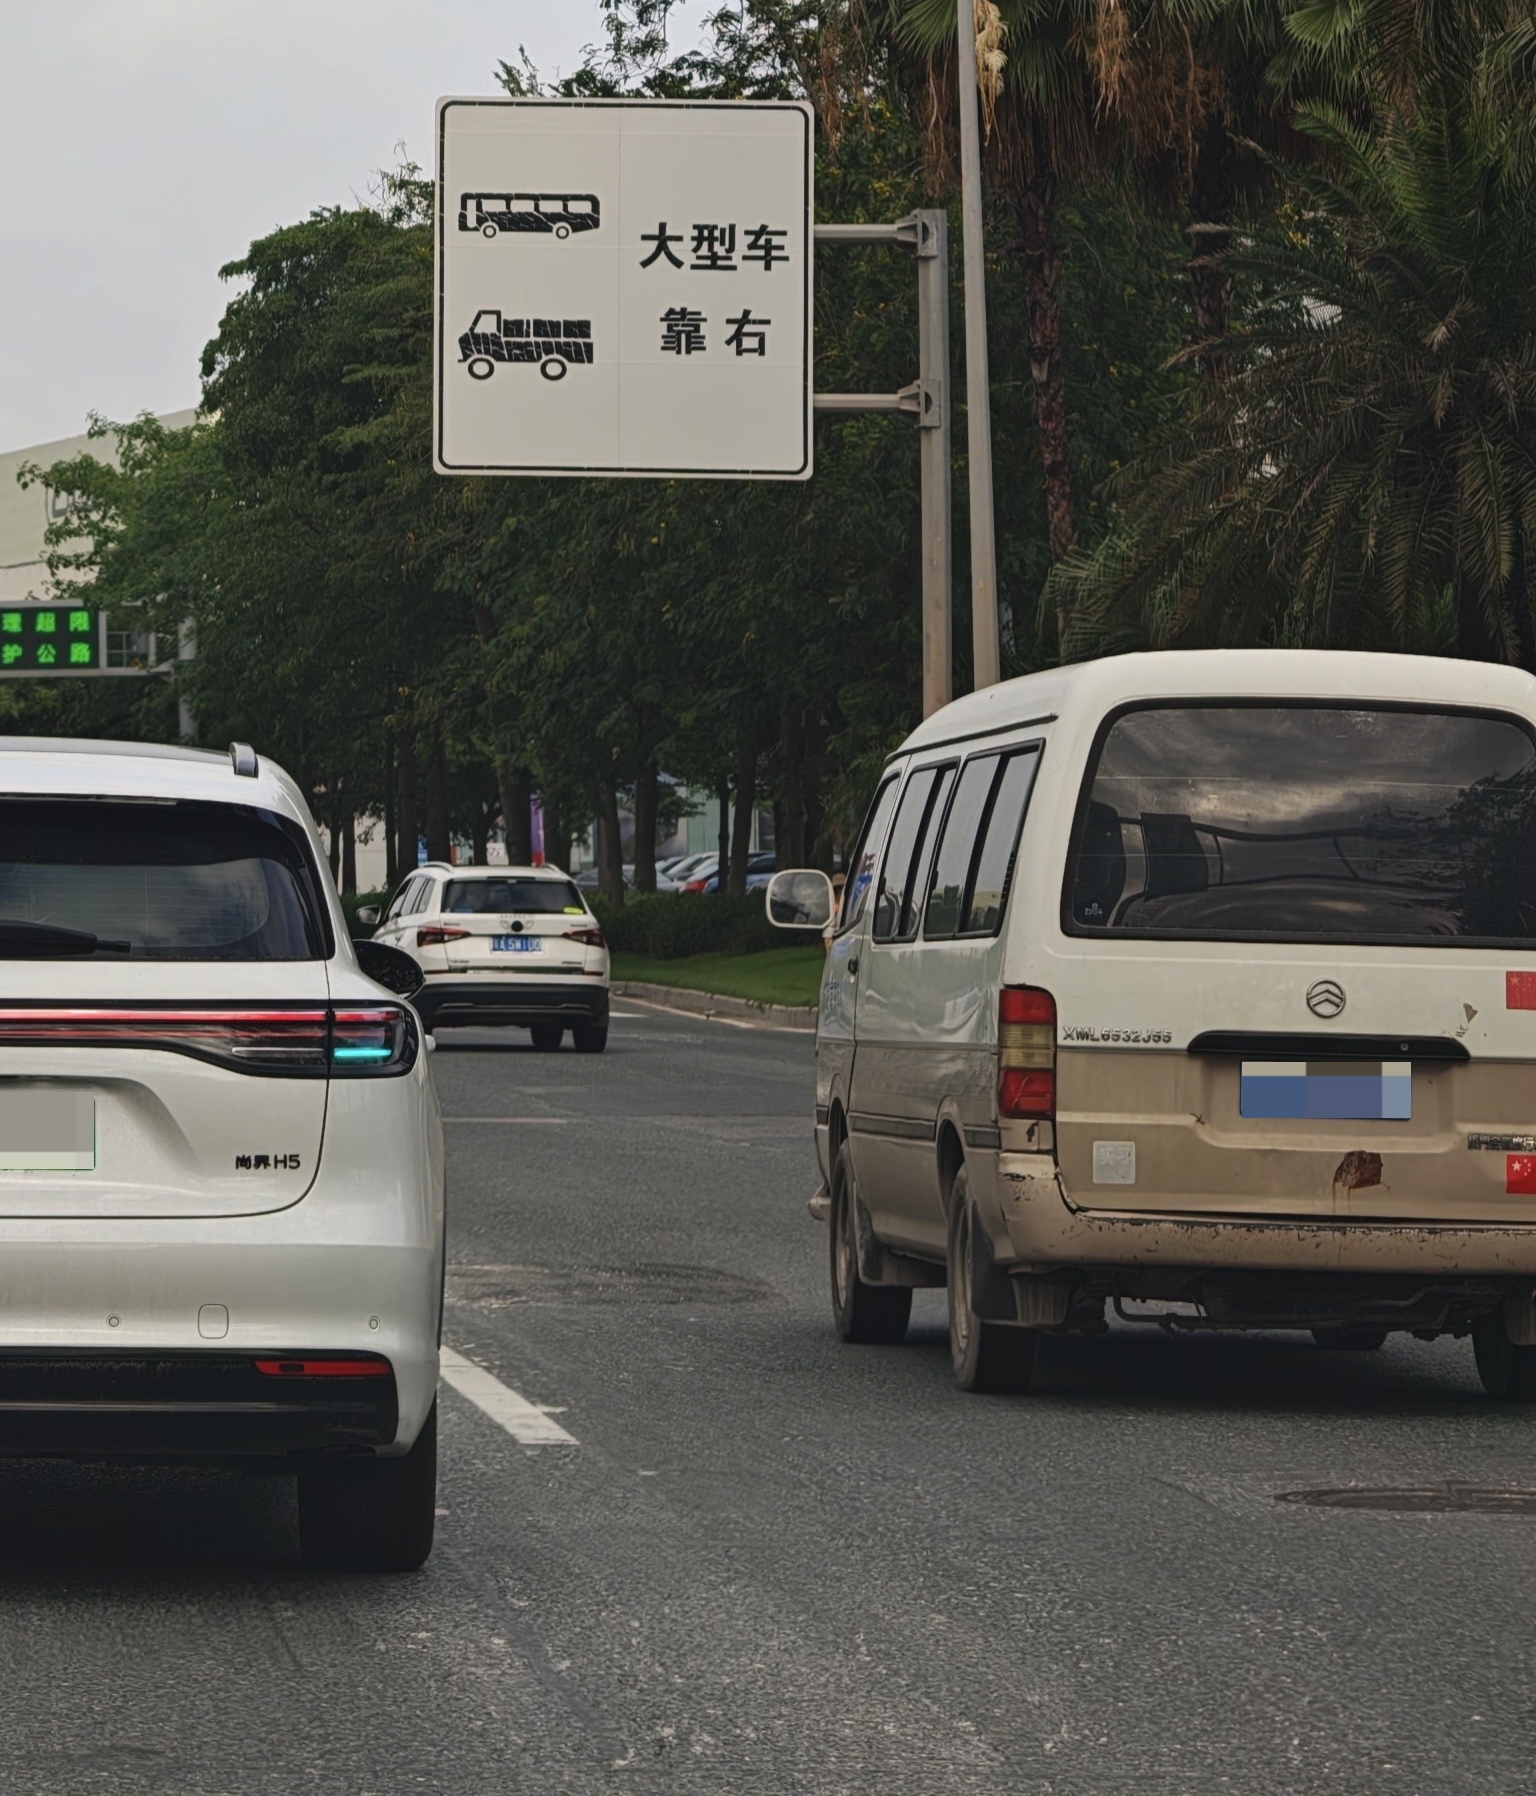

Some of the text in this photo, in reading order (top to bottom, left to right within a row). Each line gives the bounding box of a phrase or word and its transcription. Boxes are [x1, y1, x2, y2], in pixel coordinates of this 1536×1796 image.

[638, 221, 790, 271] 大型车
[659, 307, 772, 357] 靠右
[1062, 1026, 1173, 1044] XML6532J55
